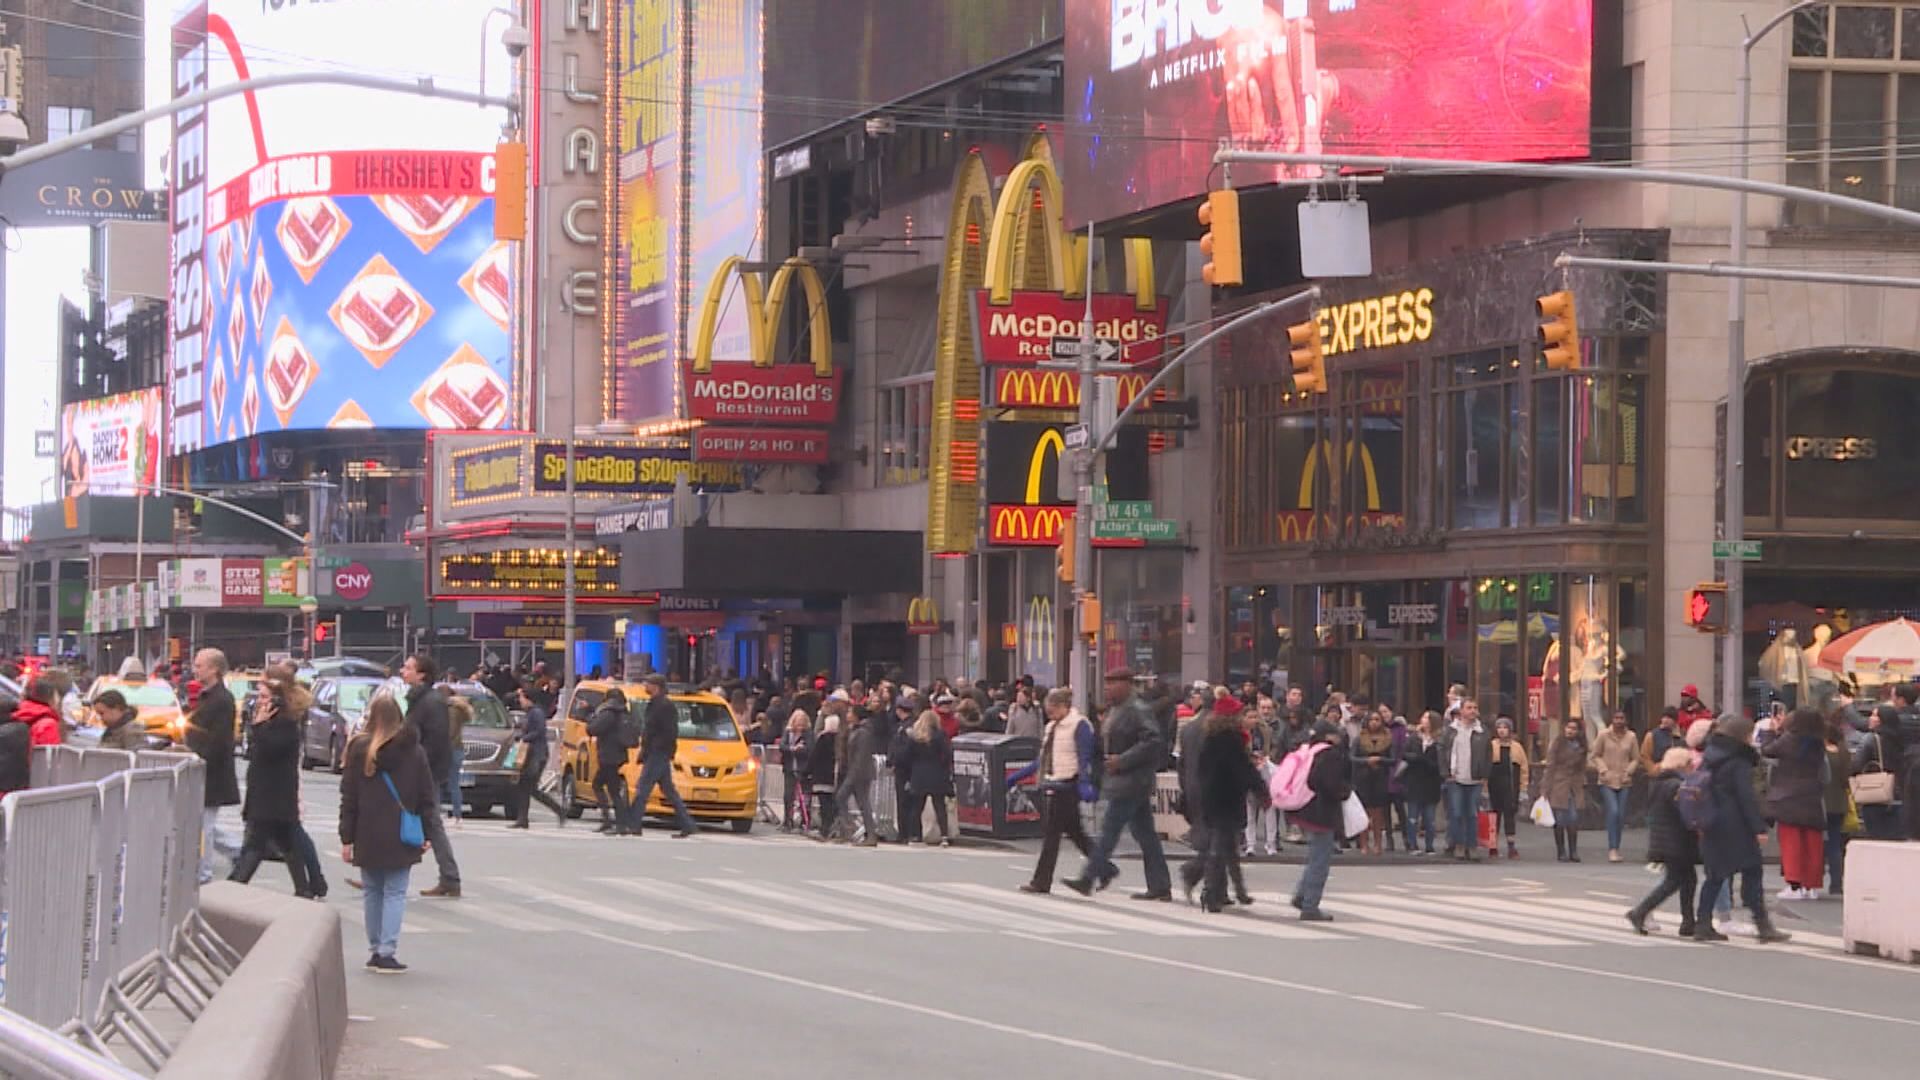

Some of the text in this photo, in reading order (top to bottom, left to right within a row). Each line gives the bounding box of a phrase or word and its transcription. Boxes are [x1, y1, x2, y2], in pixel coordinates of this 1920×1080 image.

[1164, 48, 1226, 83] NETFLIX
[1316, 288, 1433, 356] EXPRESS
[694, 380, 833, 402] McDonald's
[715, 402, 809, 416] Restaurant
[120, 427, 128, 461] 2
[702, 438, 744, 451] OPEN
[749, 440, 767, 451] 24
[543, 453, 636, 484] SPNGEBOB
[1107, 503, 1120, 519] W
[1124, 503, 1141, 518] 46
[595, 513, 624, 536] CHANGE
[652, 508, 668, 529] ATM
[1138, 521, 1170, 535] Equity
[225, 568, 260, 578] STEP
[336, 574, 371, 588] CNY
[225, 586, 260, 595] GAME
[660, 597, 720, 609] MONEY
[1388, 604, 1439, 624] EXPRESS
